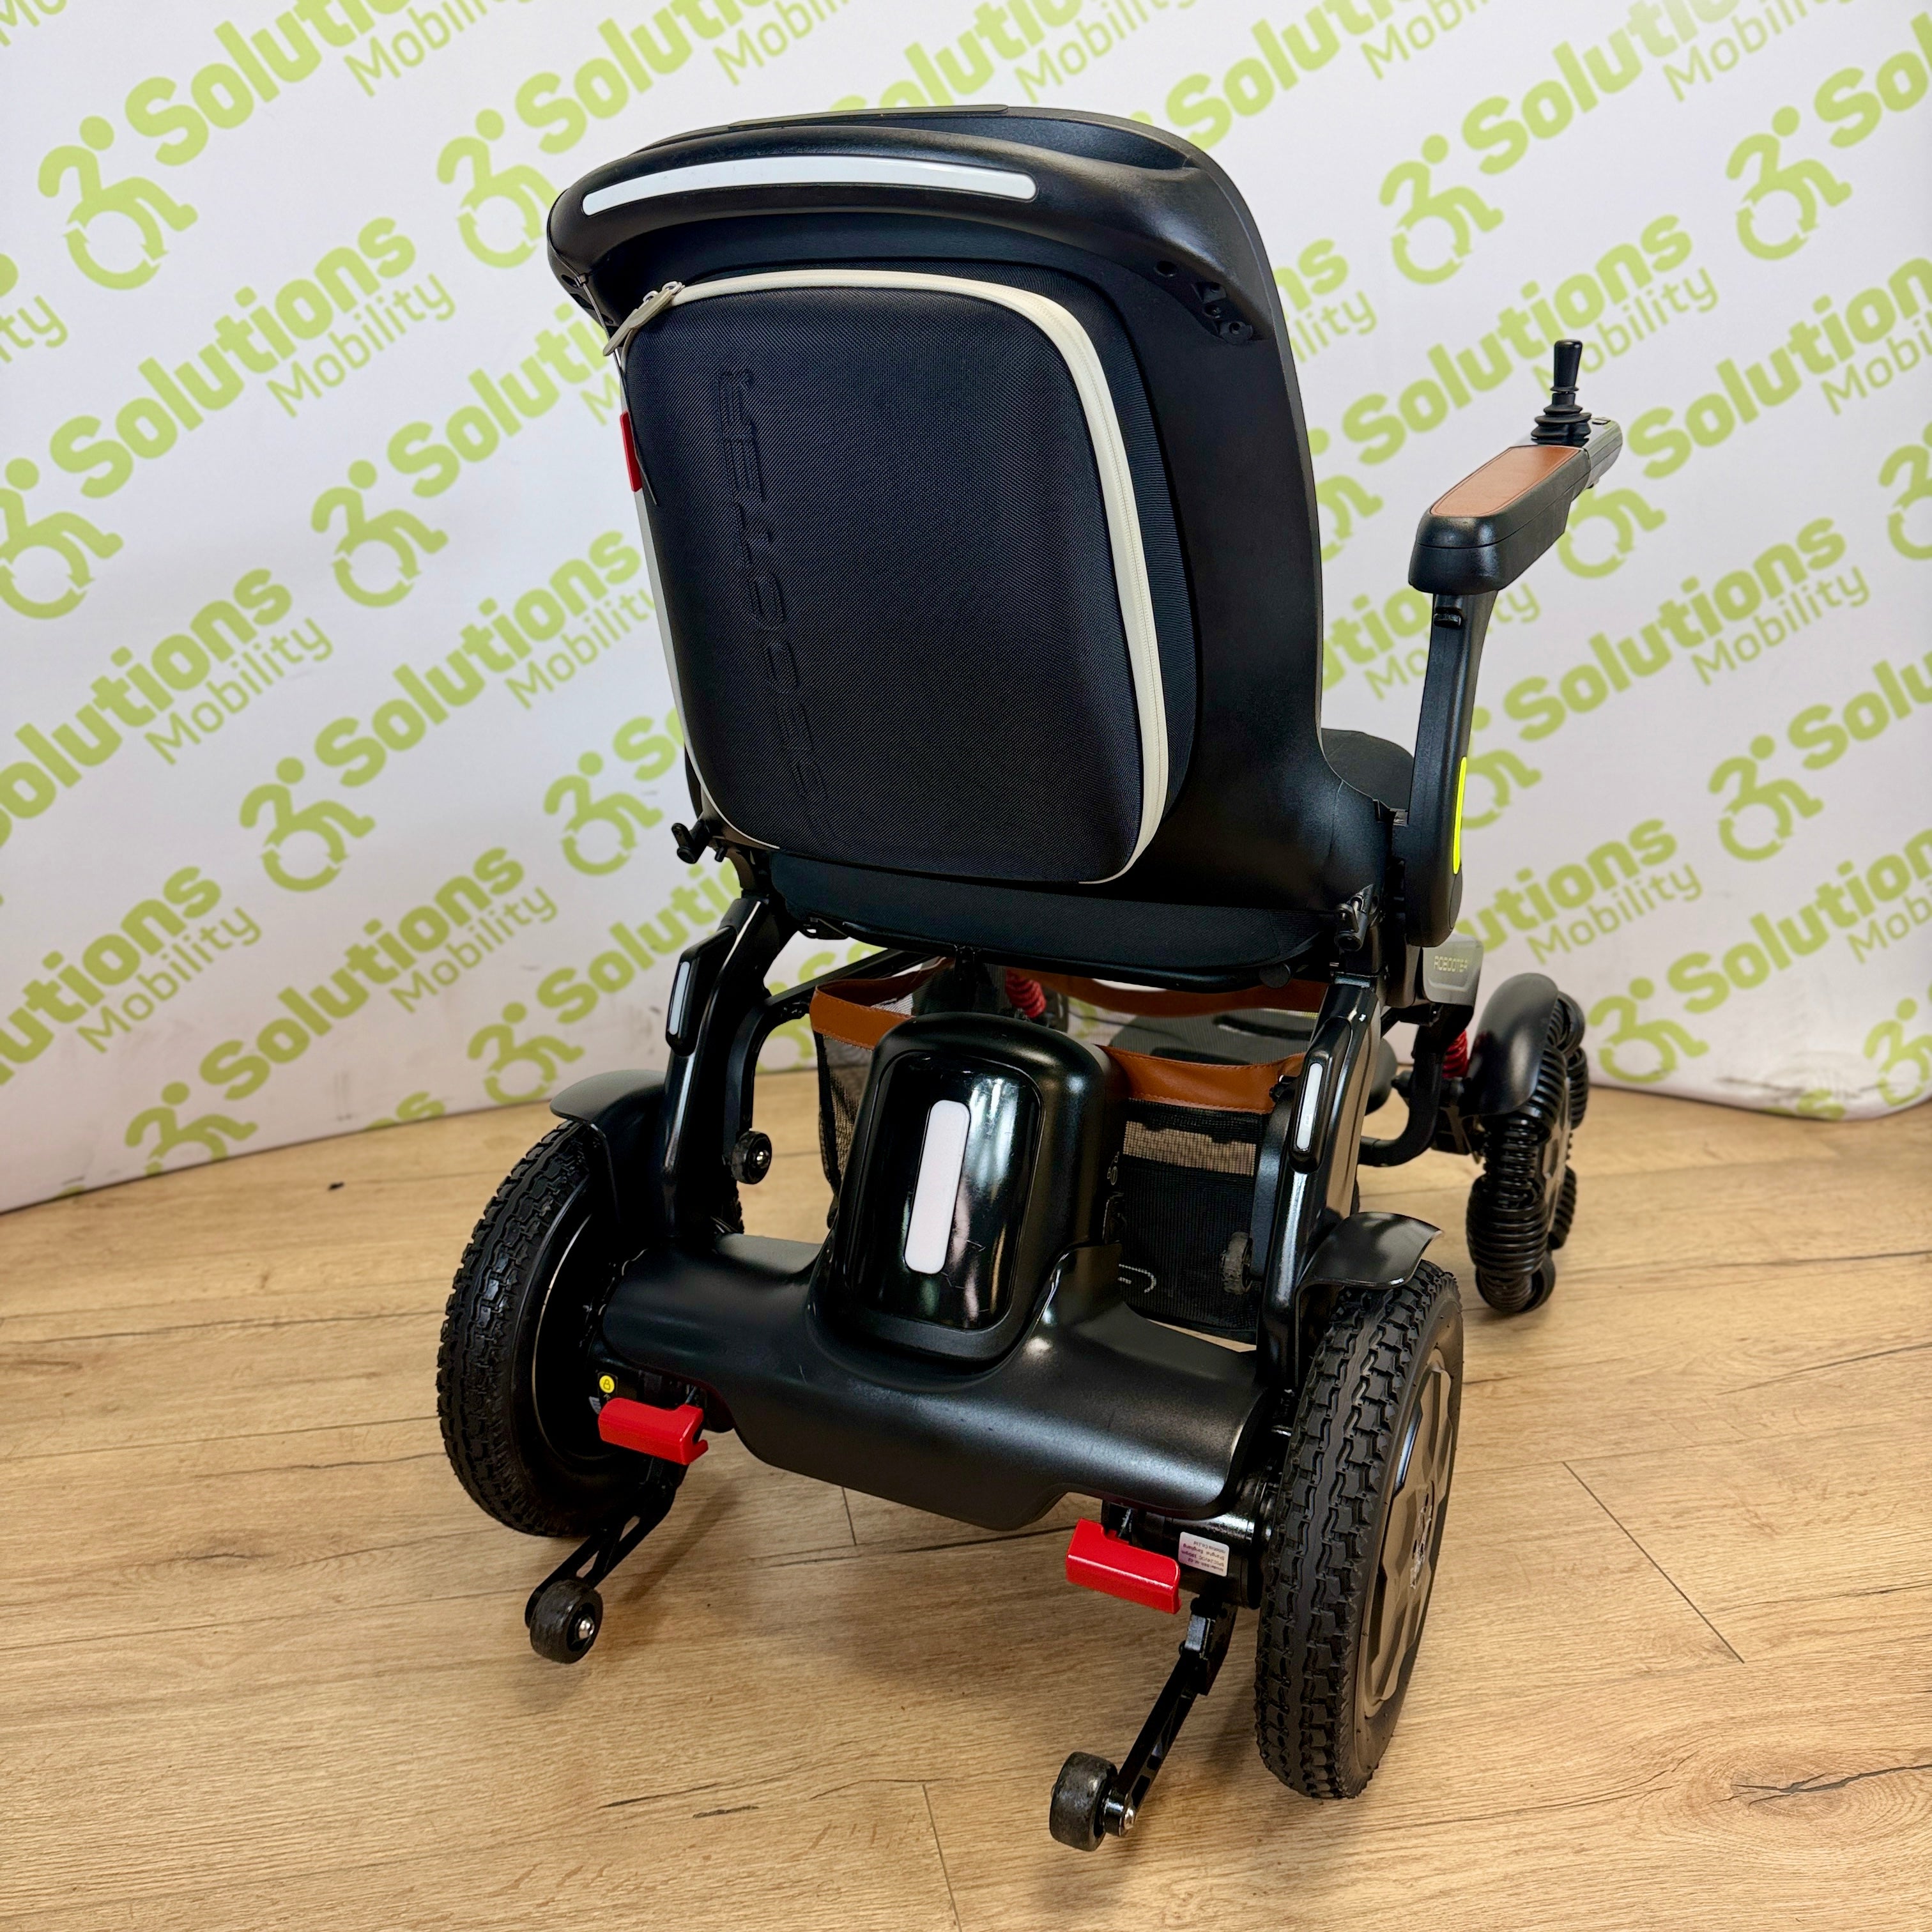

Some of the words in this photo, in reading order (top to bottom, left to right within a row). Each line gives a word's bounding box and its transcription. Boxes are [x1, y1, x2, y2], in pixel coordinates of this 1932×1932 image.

[50, 217, 416, 498] Solutions
[266, 273, 456, 418] Mobility
[1342, 215, 1692, 466] Solutions
[0, 569, 292, 849] olutions
[144, 618, 334, 765] Mobility
[314, 530, 641, 787] Solutions
[1503, 518, 1846, 741] Solutions
[1690, 566, 1871, 686] Mobility
[77, 906, 262, 1054] Mobility
[199, 847, 524, 1101] Solutions
[388, 887, 558, 1013] Mobility
[1526, 864, 1703, 965] Mobility
